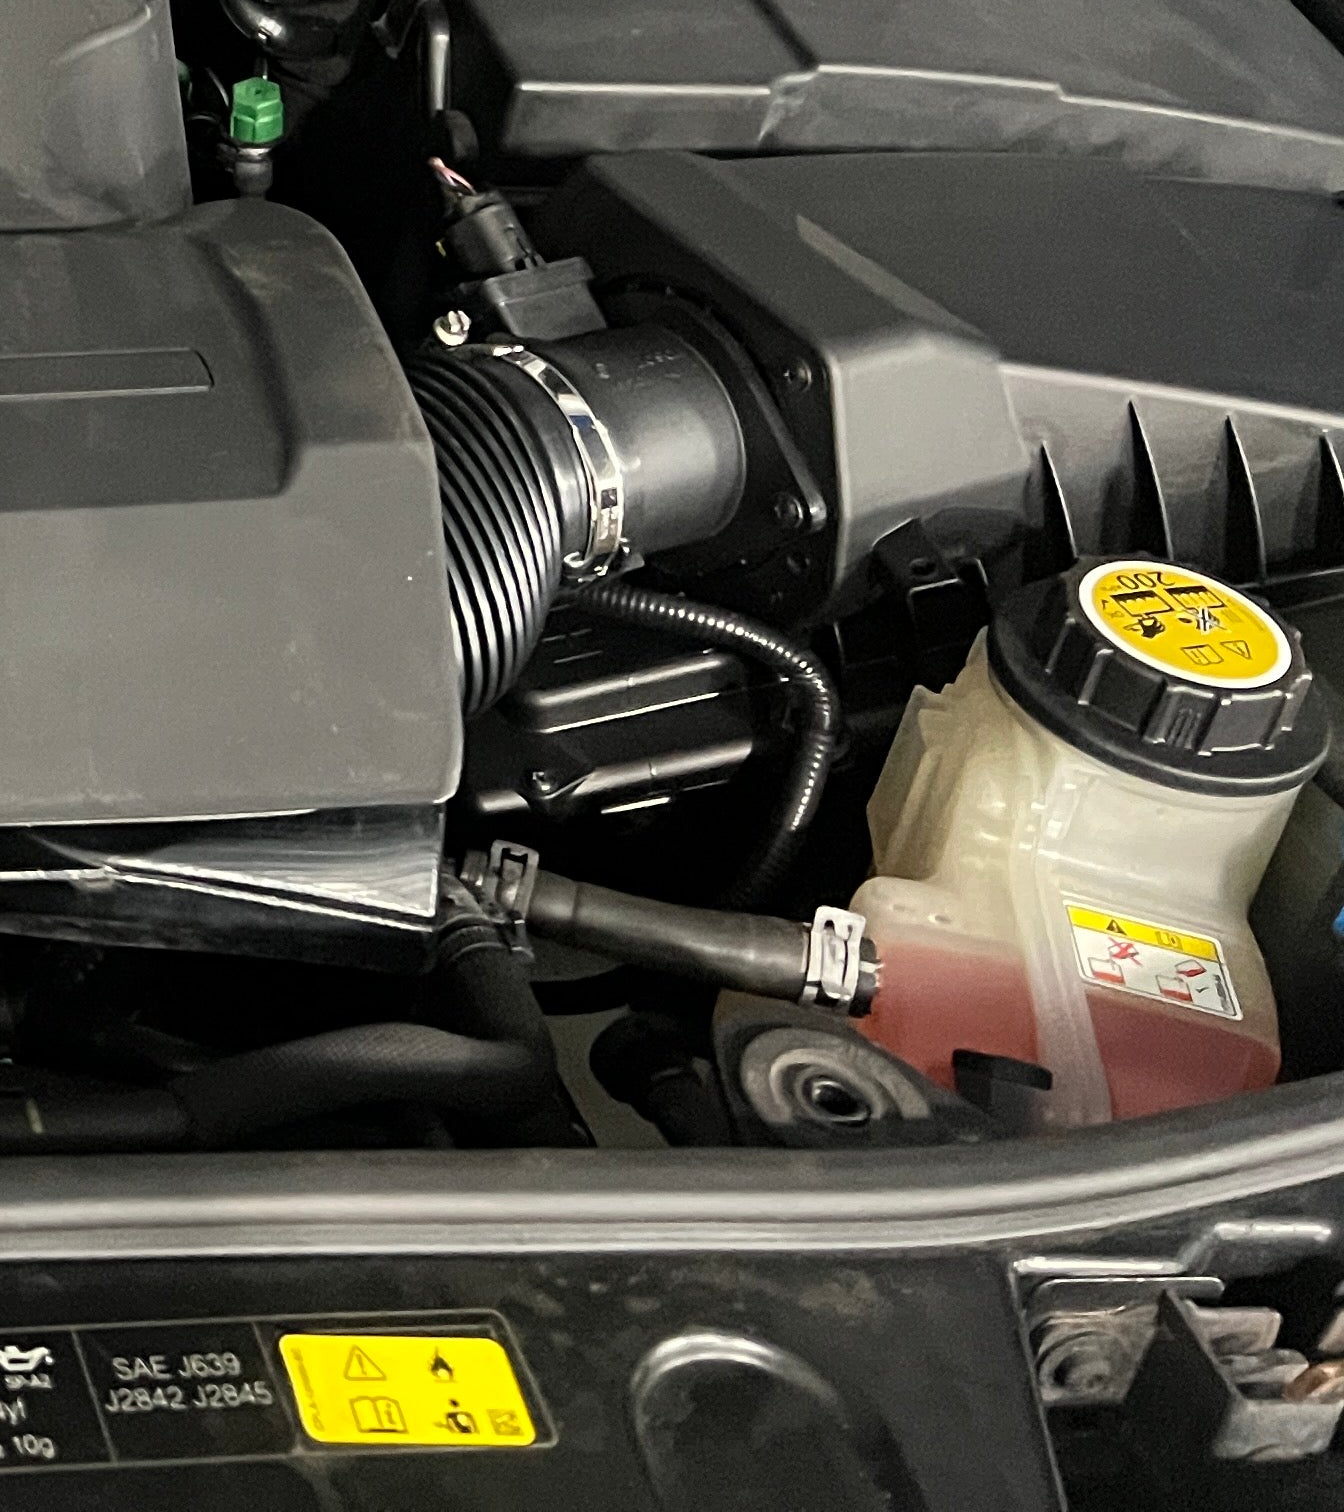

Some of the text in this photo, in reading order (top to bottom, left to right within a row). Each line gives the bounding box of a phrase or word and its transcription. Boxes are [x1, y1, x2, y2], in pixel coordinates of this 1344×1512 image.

[1116, 571, 1176, 590] 200
[112, 1351, 242, 1381] SAE J639
[104, 1381, 273, 1413] J2842 J2845
[12, 1433, 56, 1459] 10g
